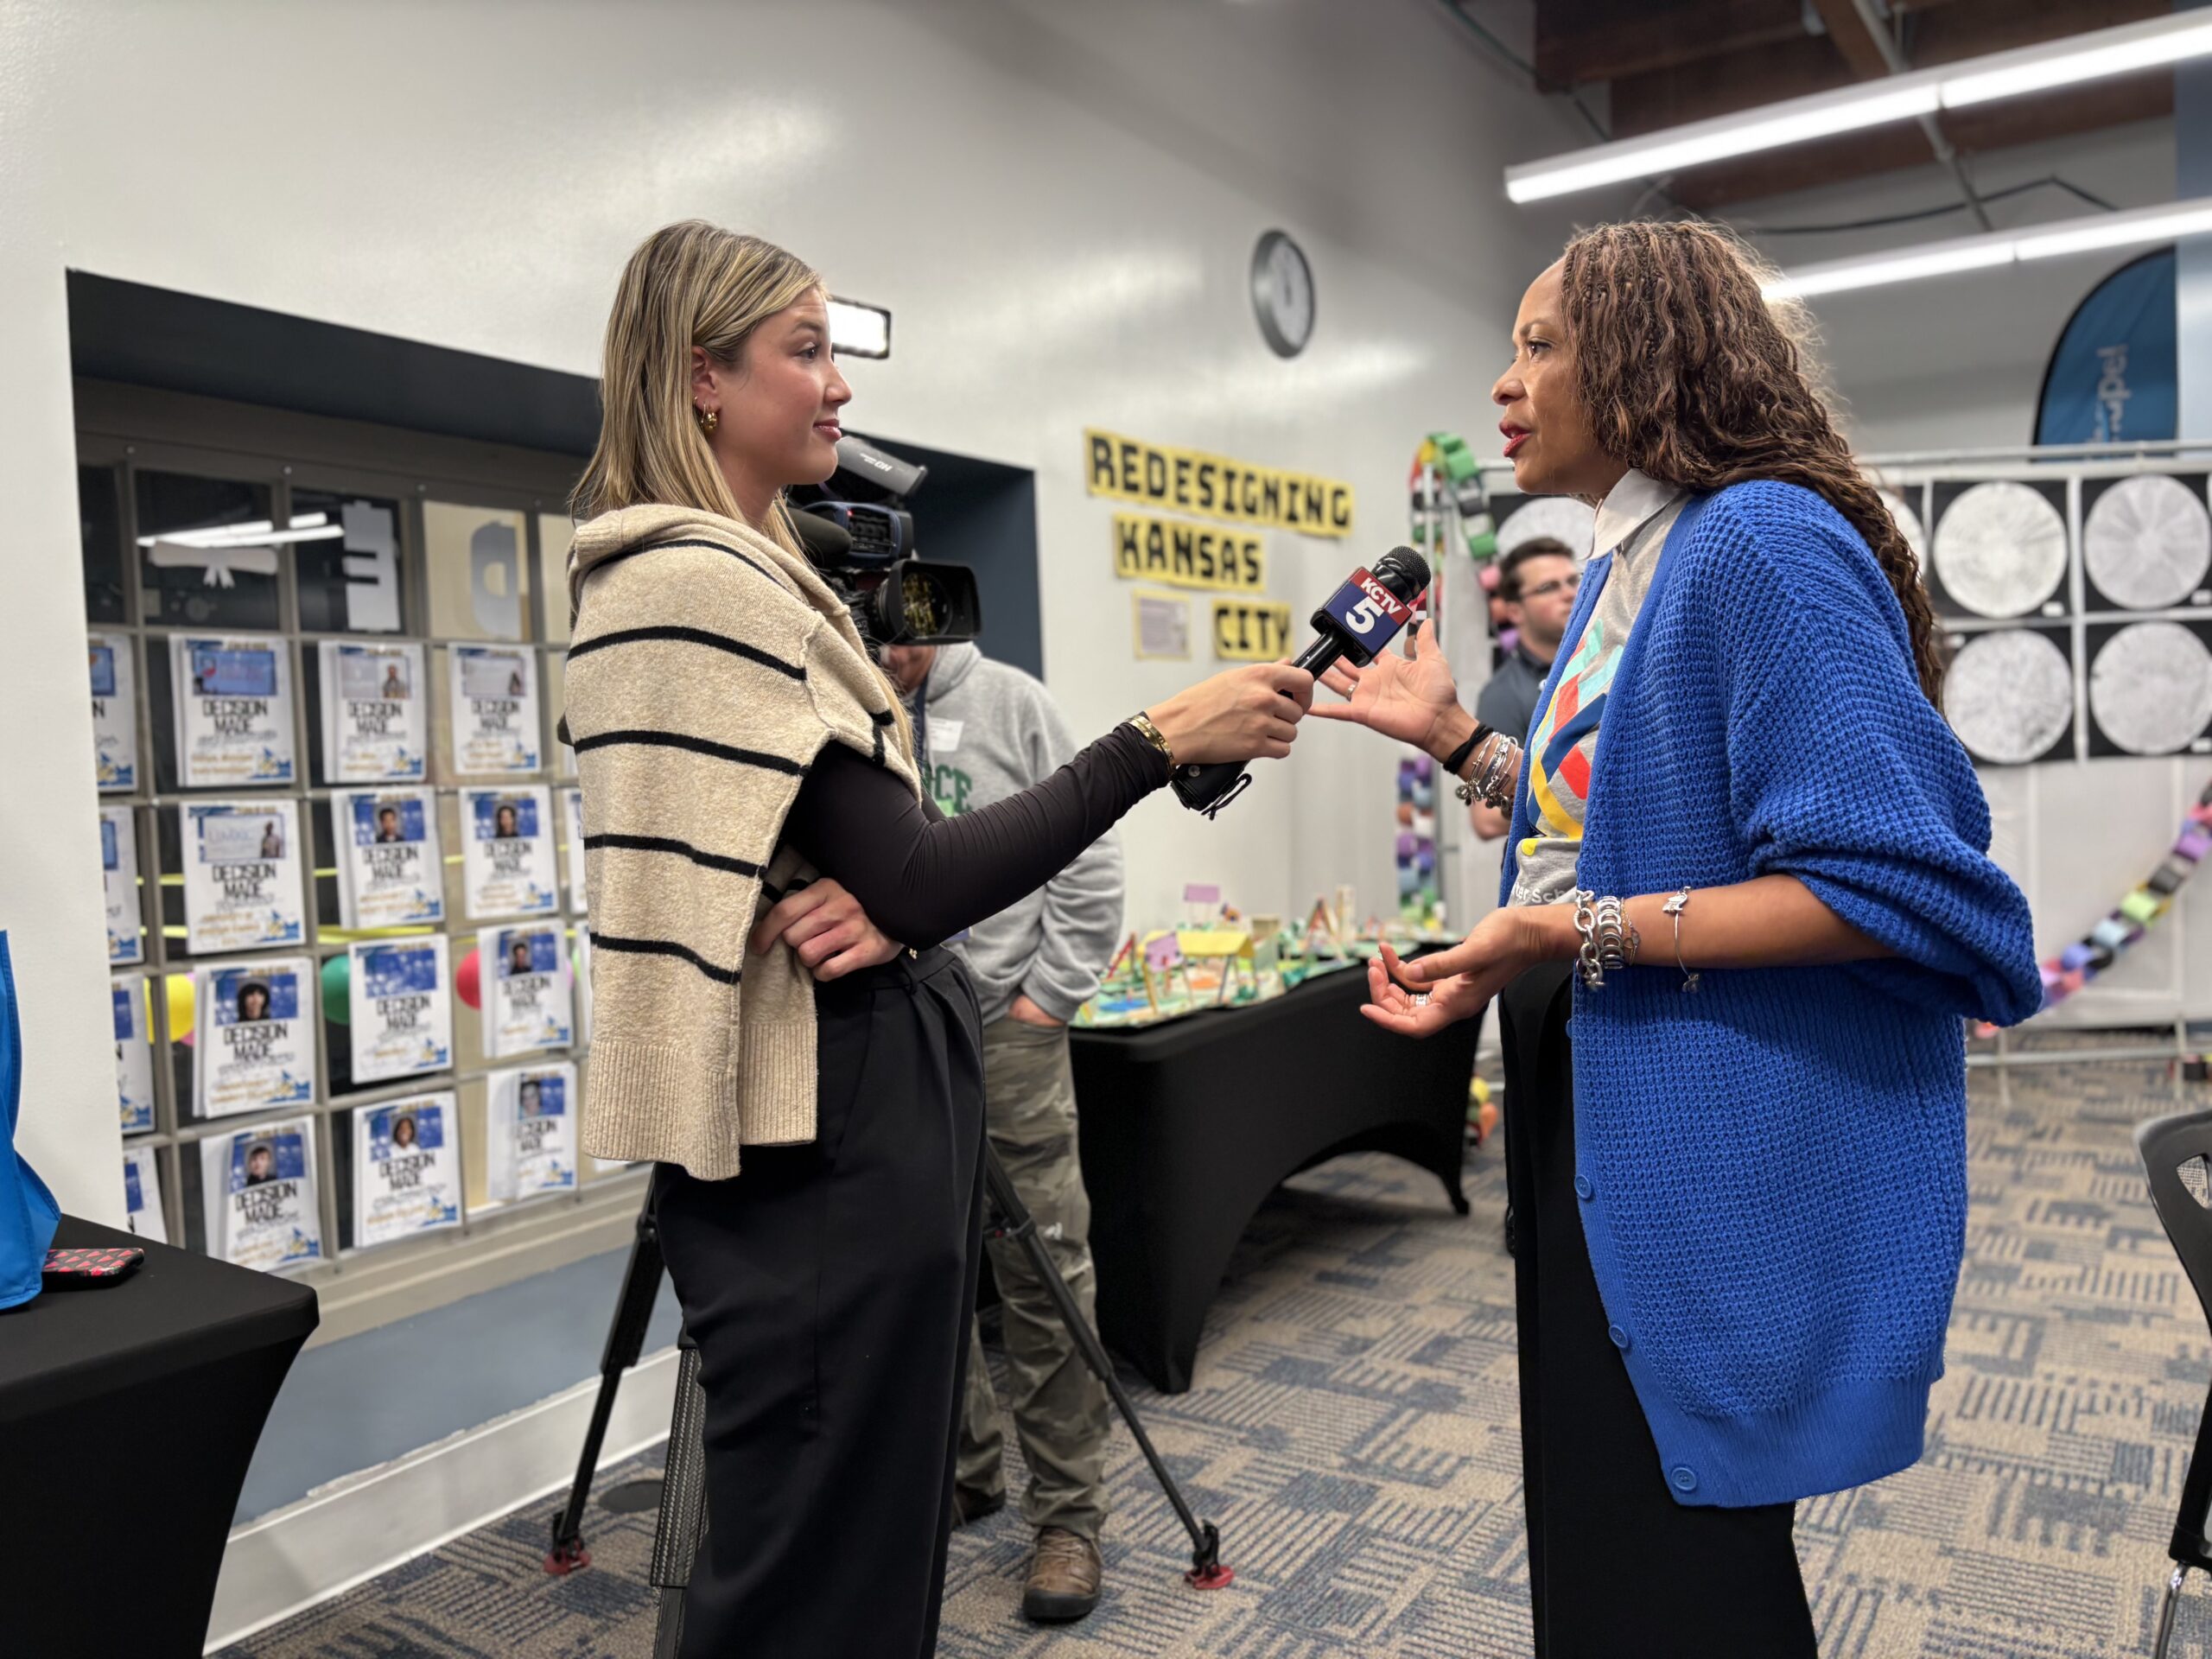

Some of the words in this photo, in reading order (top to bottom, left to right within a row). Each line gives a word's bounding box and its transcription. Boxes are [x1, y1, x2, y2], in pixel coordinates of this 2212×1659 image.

[1090, 435, 1350, 527] REDESIGNING
[1116, 521, 1260, 584] KANSAS
[1360, 577, 1402, 614] KCTV
[1216, 607, 1290, 652] CITY
[1345, 595, 1384, 634] 5
[201, 698, 268, 717] DECISION
[213, 864, 276, 882] DECISION
[1514, 881, 1530, 900] ter
[1532, 888, 1567, 903] Sch
[223, 1023, 288, 1046] DECISION
